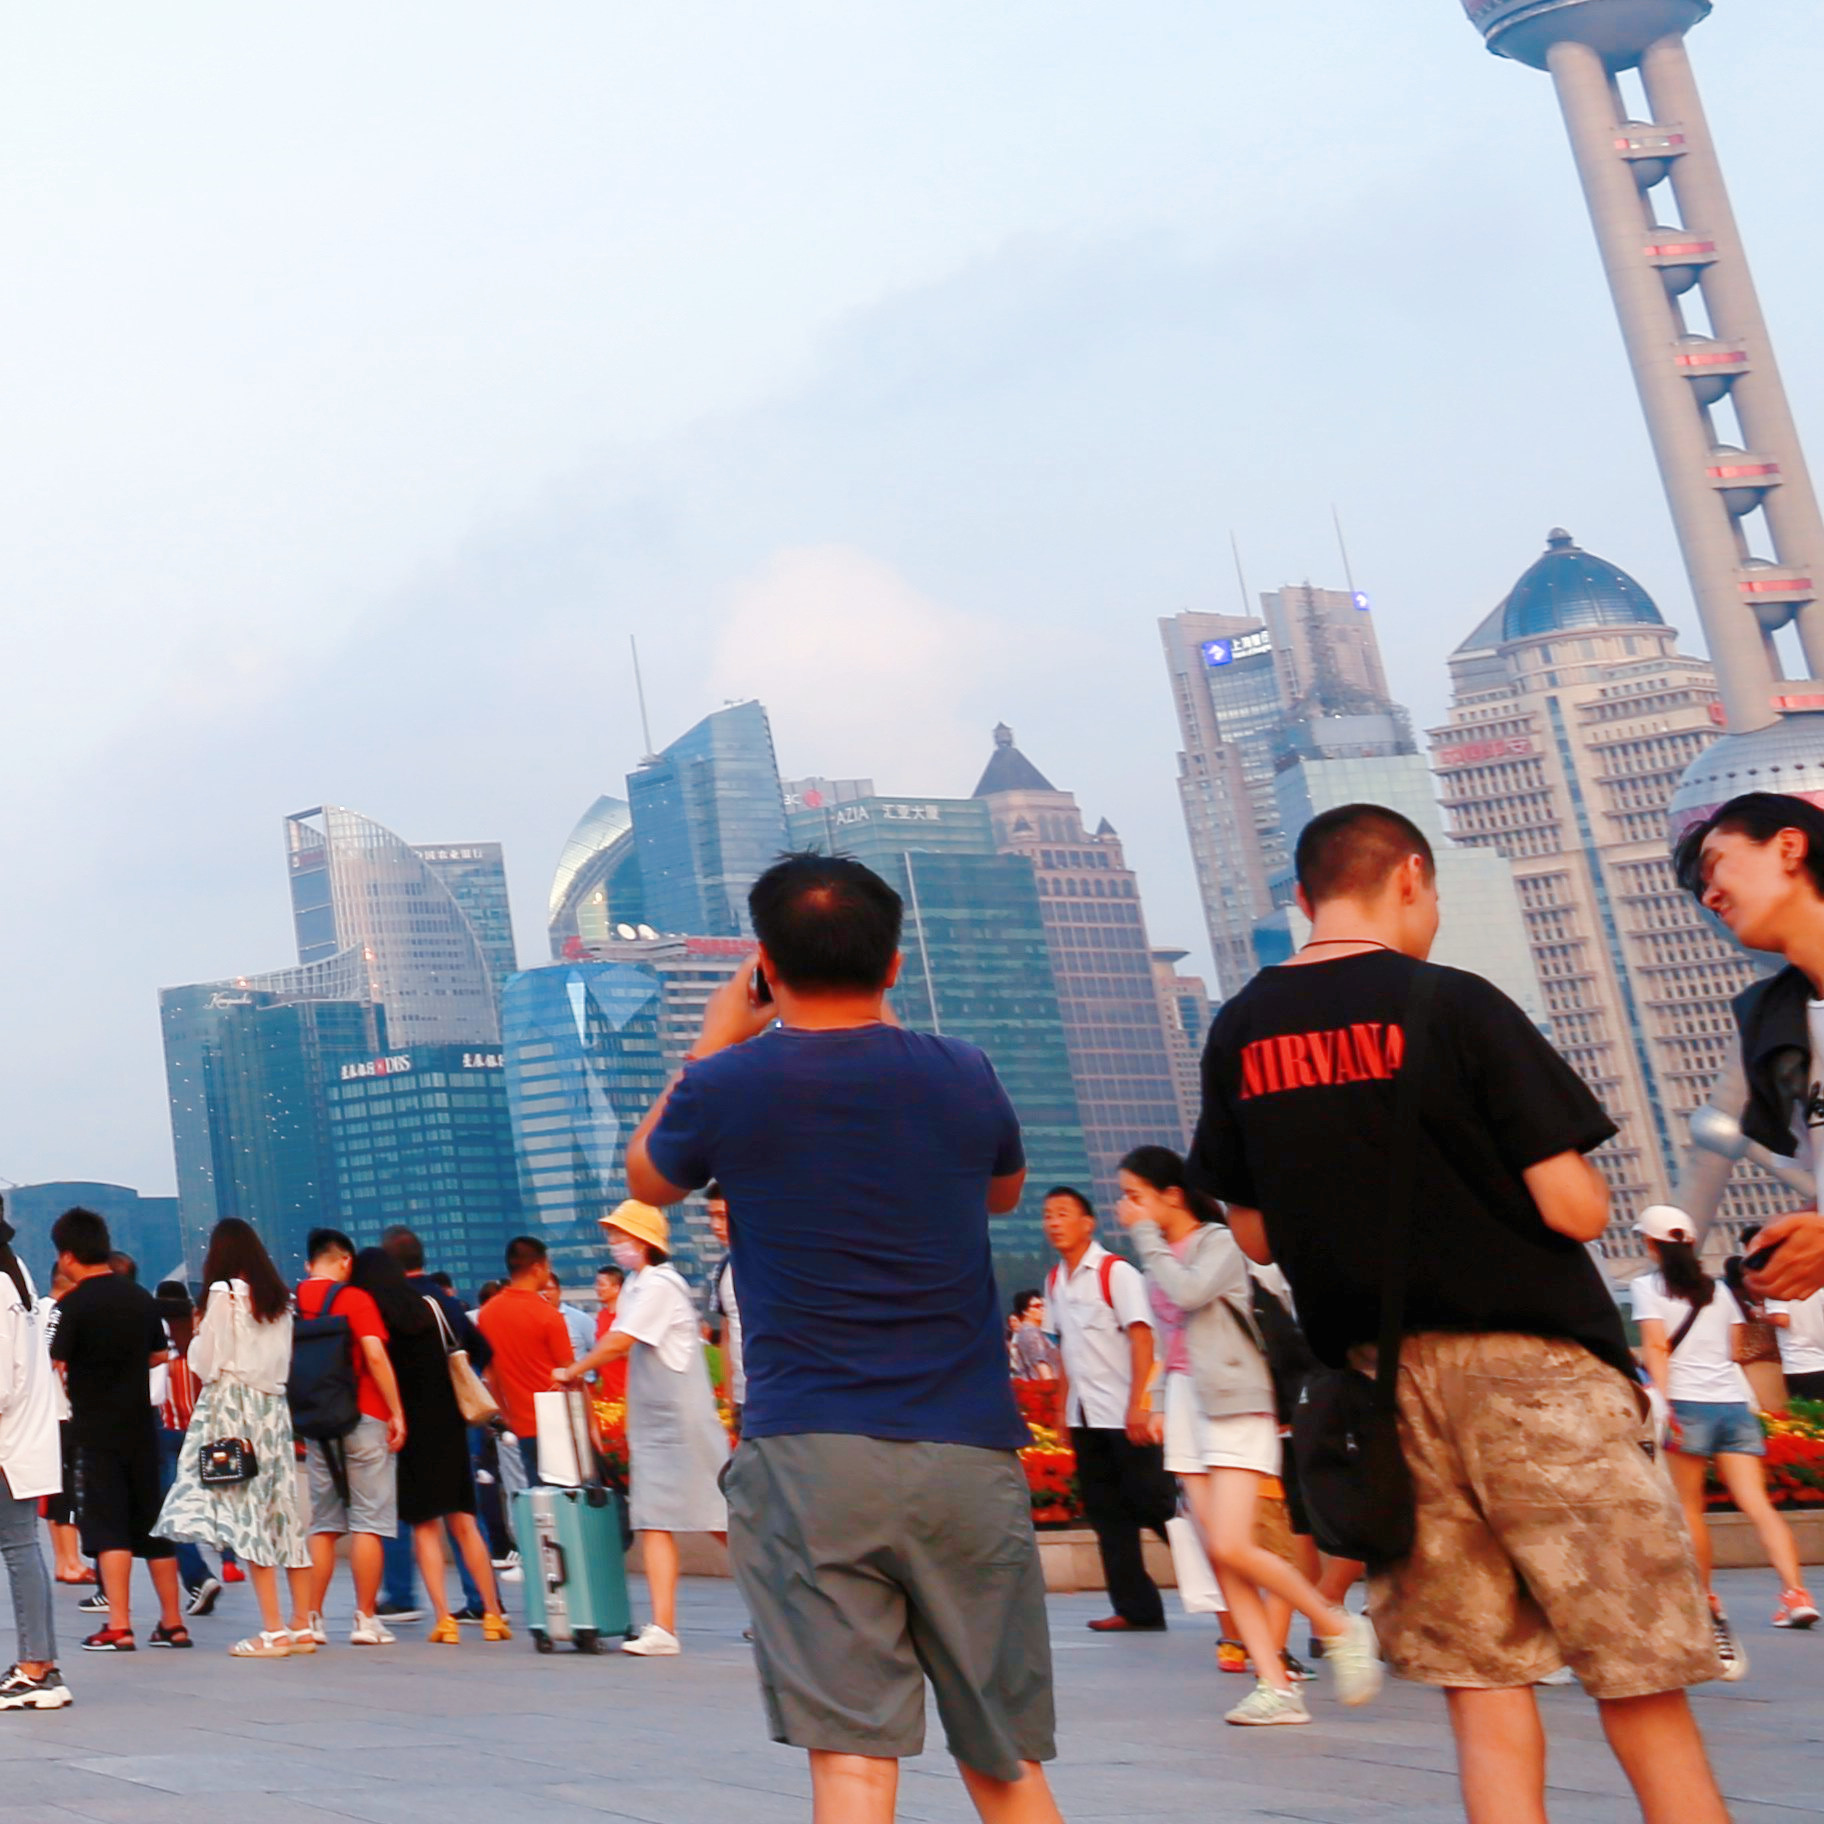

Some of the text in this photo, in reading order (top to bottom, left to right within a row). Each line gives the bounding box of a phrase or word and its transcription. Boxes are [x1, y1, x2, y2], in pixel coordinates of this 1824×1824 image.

[836, 805, 870, 826] AZIA
[882, 804, 942, 821] 汇亚大厦
[384, 1054, 411, 1073] DBS
[1239, 1023, 1406, 1100] NIRVANA
